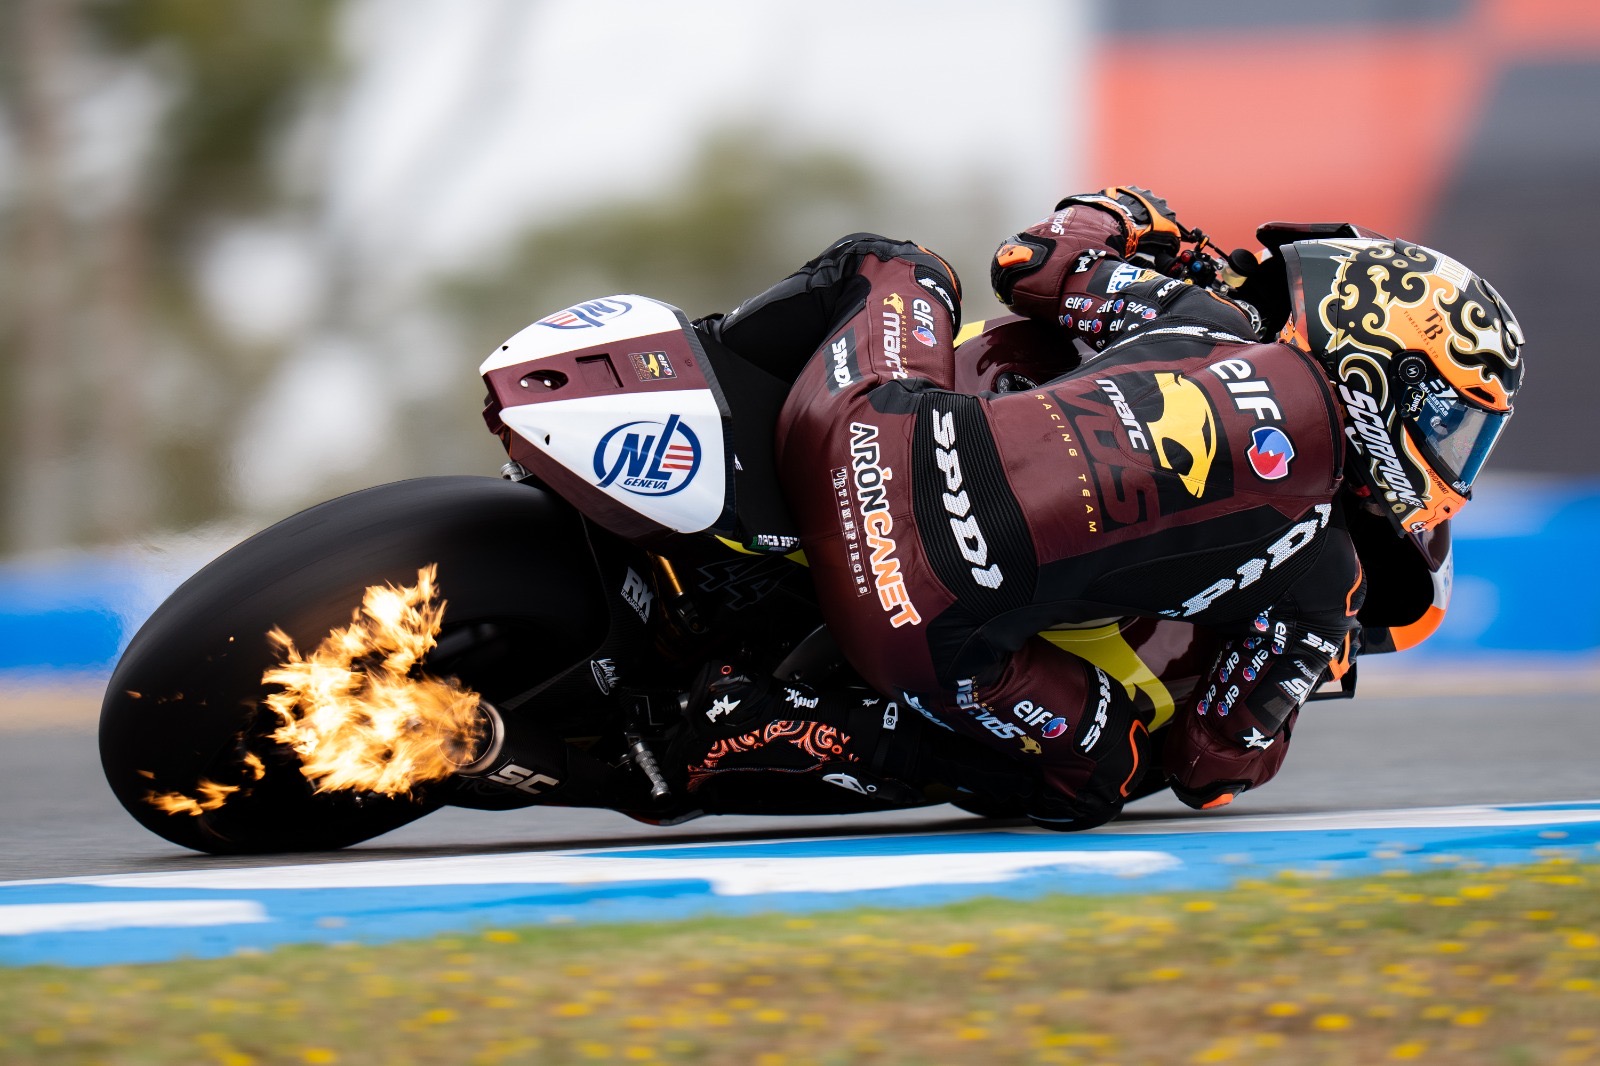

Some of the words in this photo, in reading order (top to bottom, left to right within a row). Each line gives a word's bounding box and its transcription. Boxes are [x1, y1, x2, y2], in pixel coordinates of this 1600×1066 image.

[912, 298, 934, 331] elf
[1065, 296, 1082, 309] elf
[1127, 301, 1148, 314] elf
[1078, 319, 1091, 332] elf
[1423, 308, 1444, 342] TB
[657, 353, 669, 369] elf
[1209, 359, 1282, 421] elf
[1095, 379, 1150, 451] marc
[1338, 384, 1418, 502] SCORPION
[1034, 394, 1078, 458] RACING
[1077, 473, 1098, 534] TEAM
[623, 477, 669, 492] GENEVA
[932, 408, 1004, 590] SPIDI
[838, 488, 868, 594] TIMEPIECES
[622, 567, 655, 619] RK
[1275, 621, 1287, 649] elf
[1225, 651, 1240, 675] elf
[1251, 649, 1269, 673] elf
[1225, 684, 1240, 709] elf
[1013, 700, 1053, 728] elf
[487, 763, 560, 795] SC
